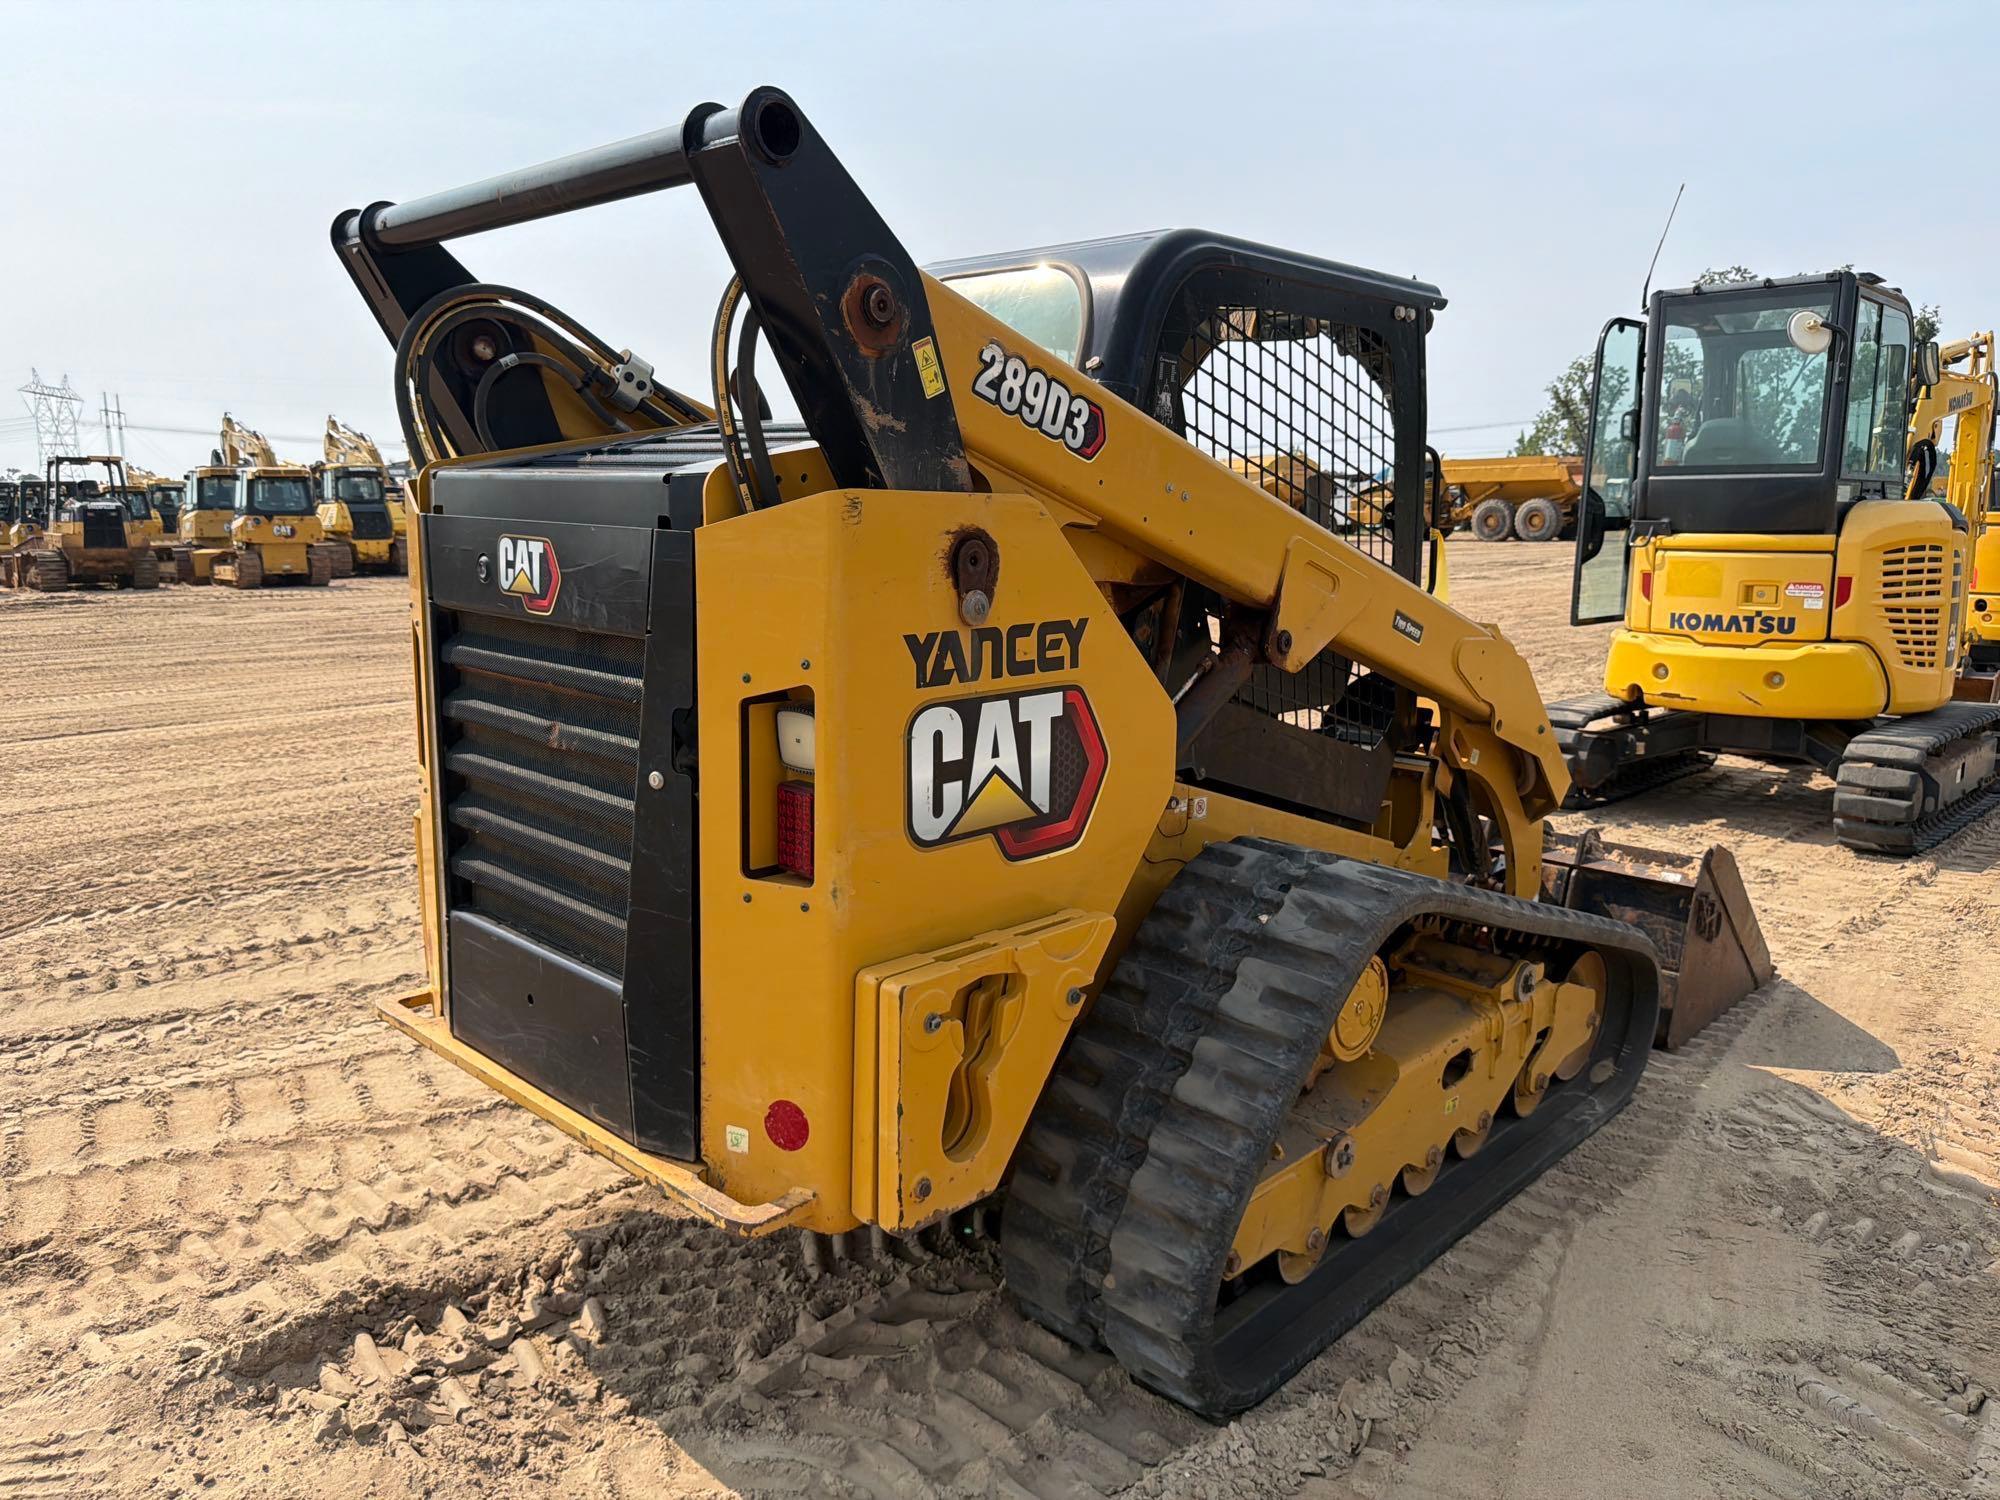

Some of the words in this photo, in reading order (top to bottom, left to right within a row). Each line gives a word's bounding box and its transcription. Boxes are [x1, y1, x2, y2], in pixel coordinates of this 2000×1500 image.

[974, 344, 1090, 449] 289D3
[273, 525, 293, 537] CAT
[500, 537, 543, 594] CAT
[903, 617, 1090, 689] YANCEY
[1670, 611, 1796, 635] KOMATSU
[911, 691, 1063, 841] CAT
